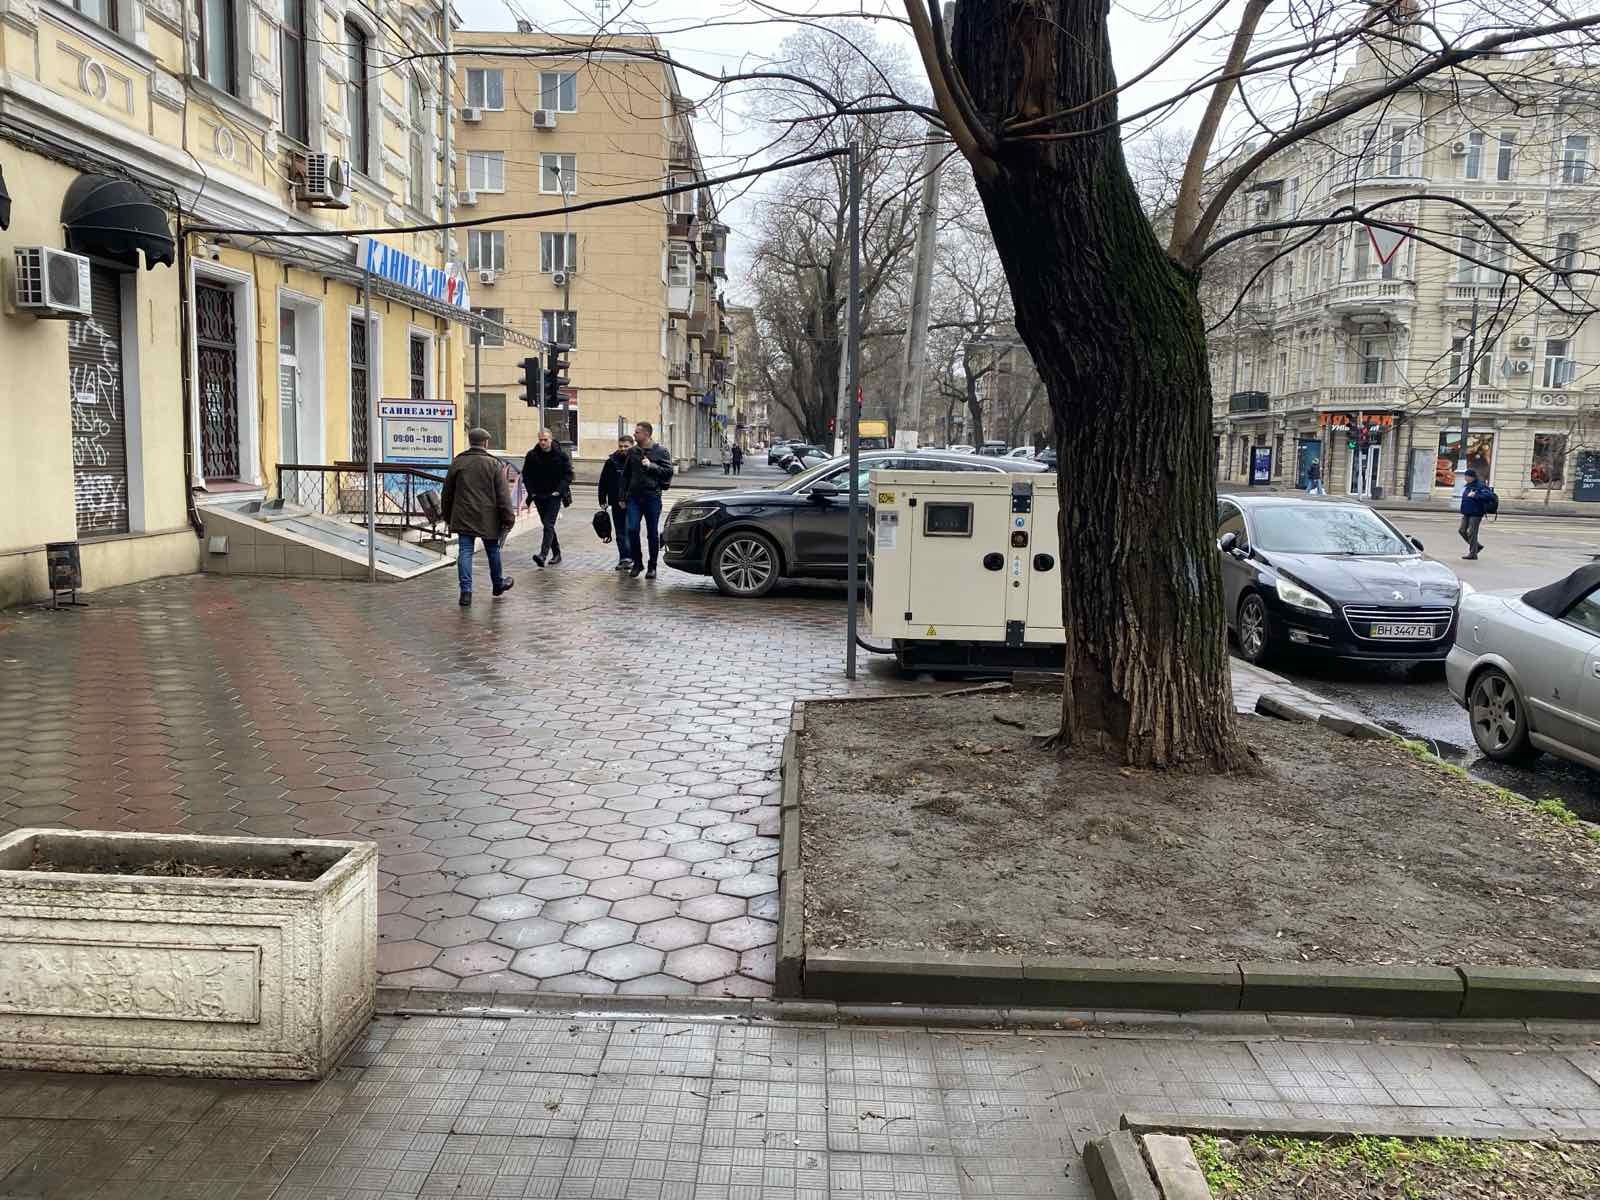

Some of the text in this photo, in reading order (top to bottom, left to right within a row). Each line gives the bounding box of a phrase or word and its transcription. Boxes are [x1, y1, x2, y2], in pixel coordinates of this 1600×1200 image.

[393, 434, 414, 443] 09:00
[422, 435, 442, 444] 18:00
[1377, 625, 1432, 636] BH 3447 EA
